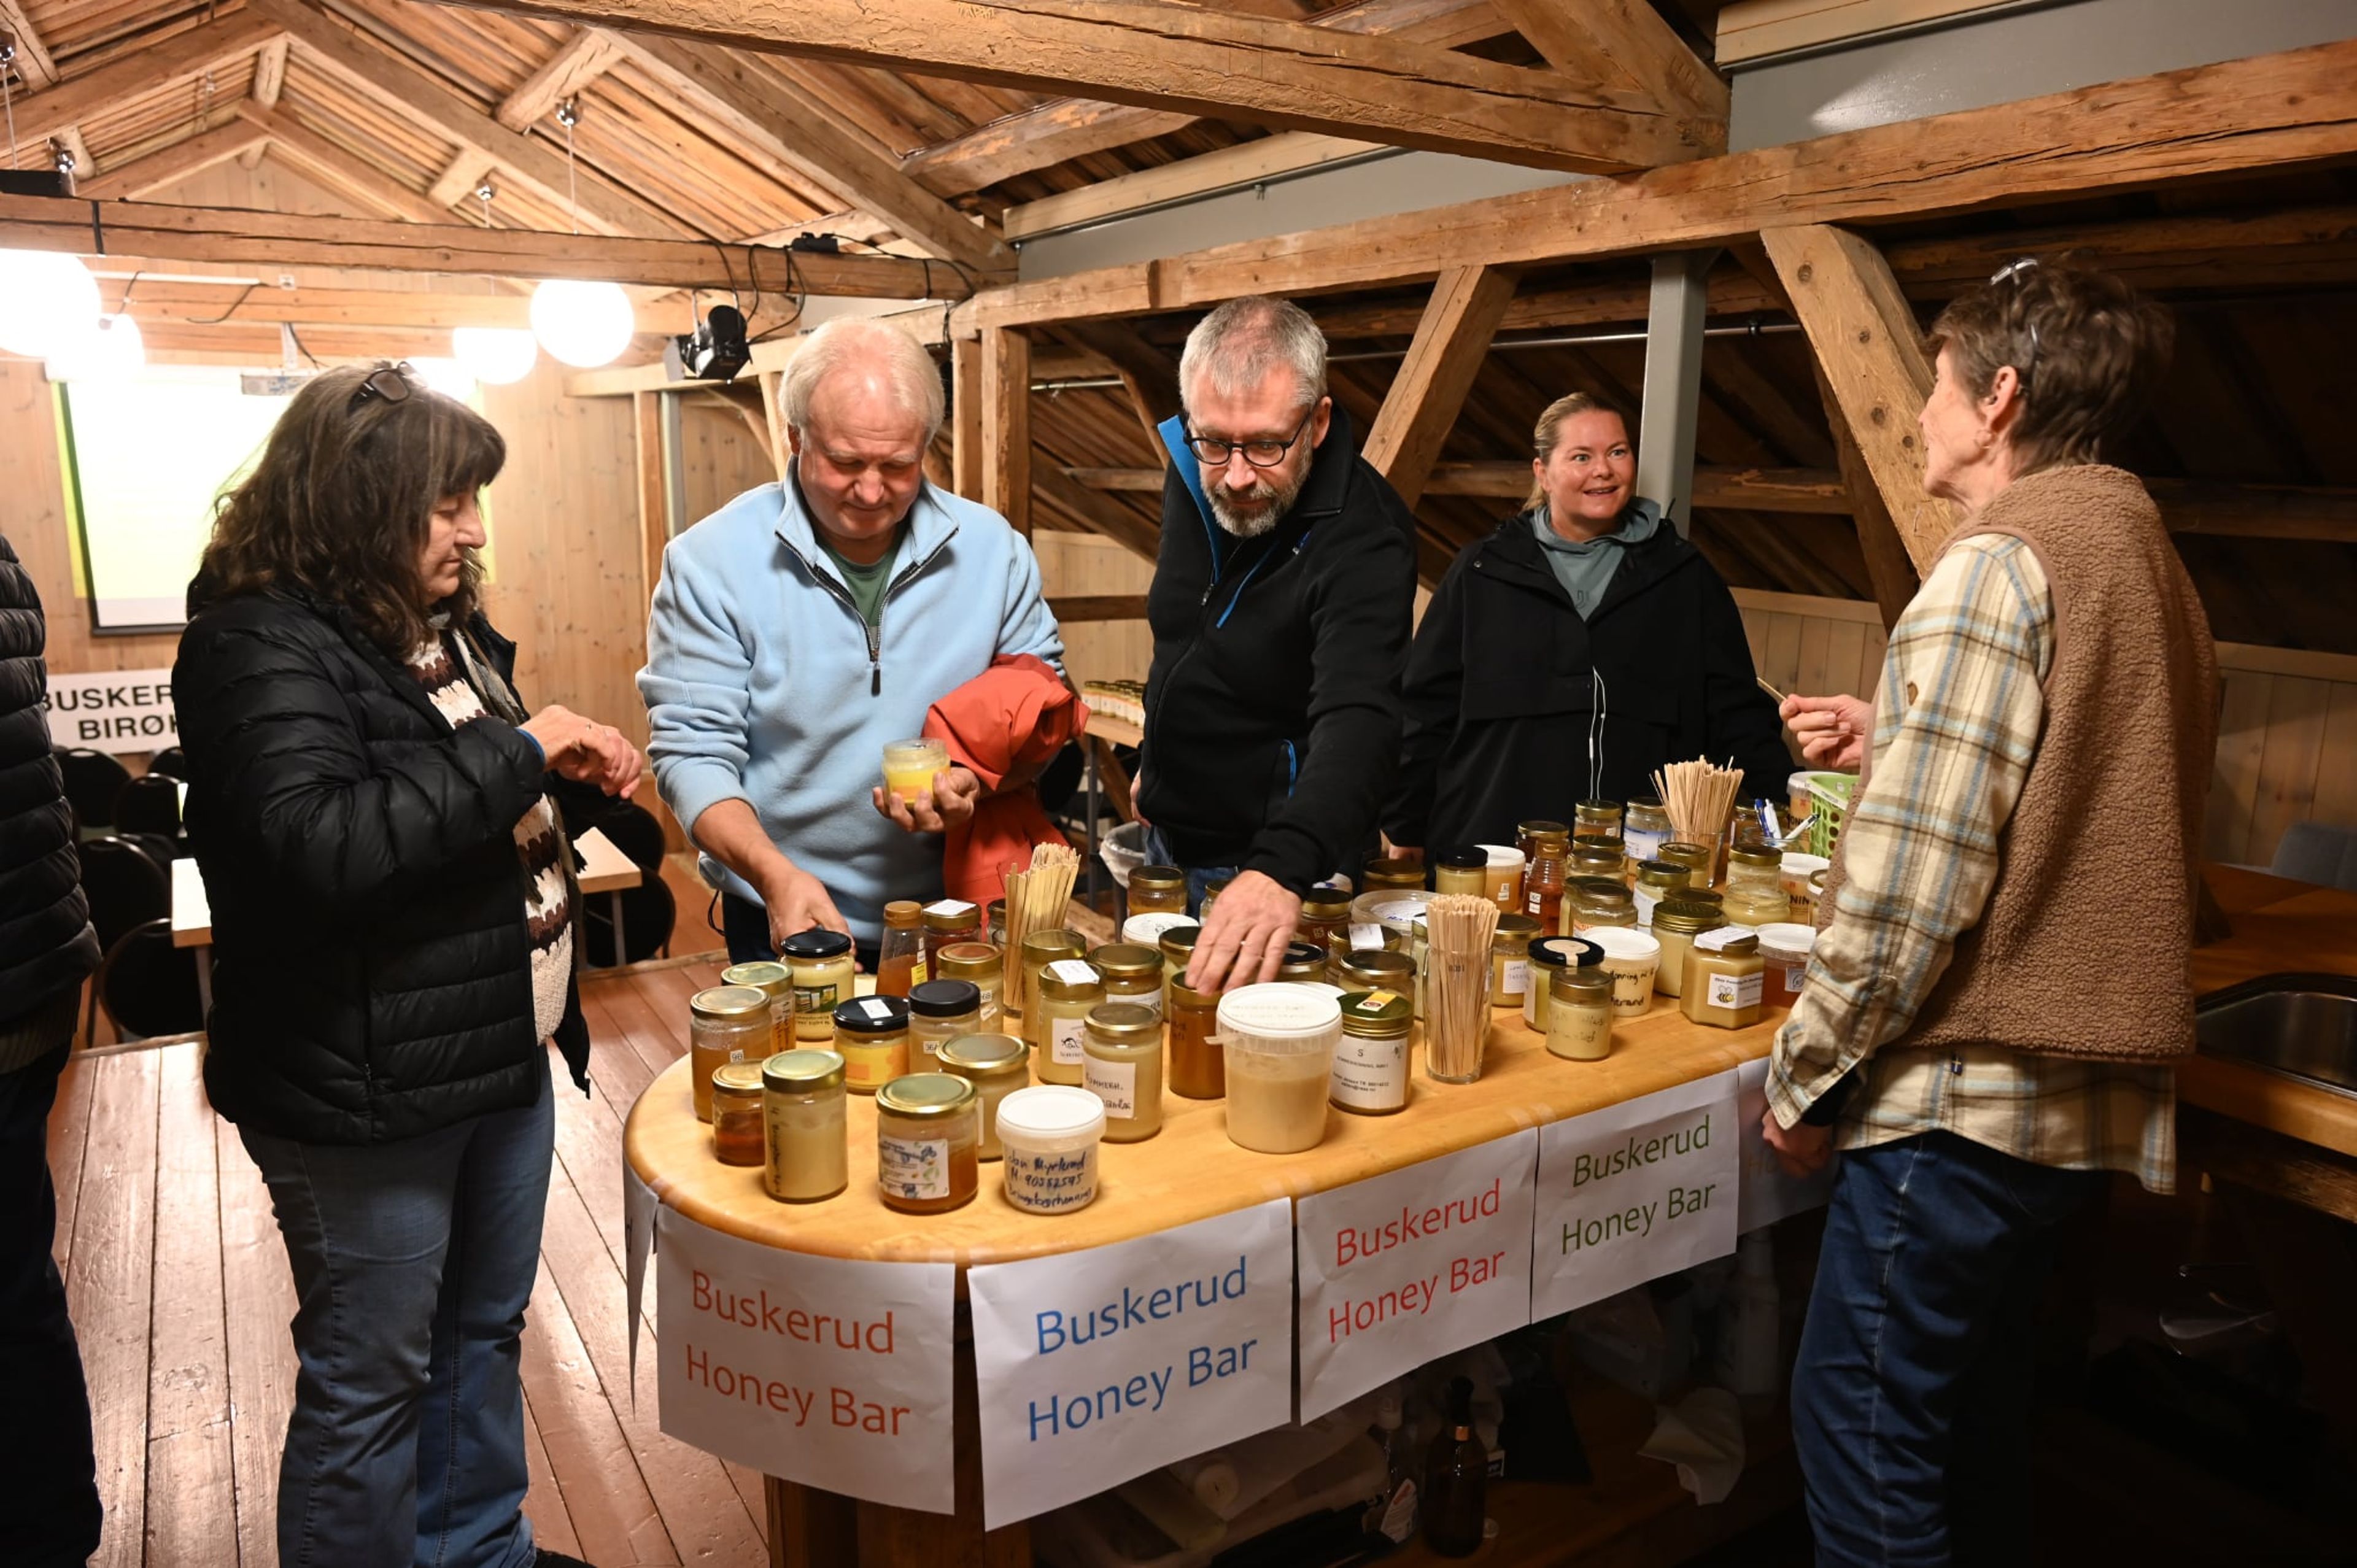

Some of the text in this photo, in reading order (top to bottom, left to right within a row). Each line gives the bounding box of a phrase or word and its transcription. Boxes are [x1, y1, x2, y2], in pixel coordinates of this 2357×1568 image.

[1573, 1113, 1710, 1188] Buskerud
[1335, 1177, 1501, 1268] Buskerud
[1562, 1183, 1716, 1255] Honey Bar
[691, 1268, 894, 1354] Buskerud
[1037, 1254, 1247, 1356] Buskerud
[1328, 1250, 1506, 1345] Honey Bar
[686, 1343, 911, 1437] Honey Bar
[1029, 1339, 1258, 1442] Honey Bar
